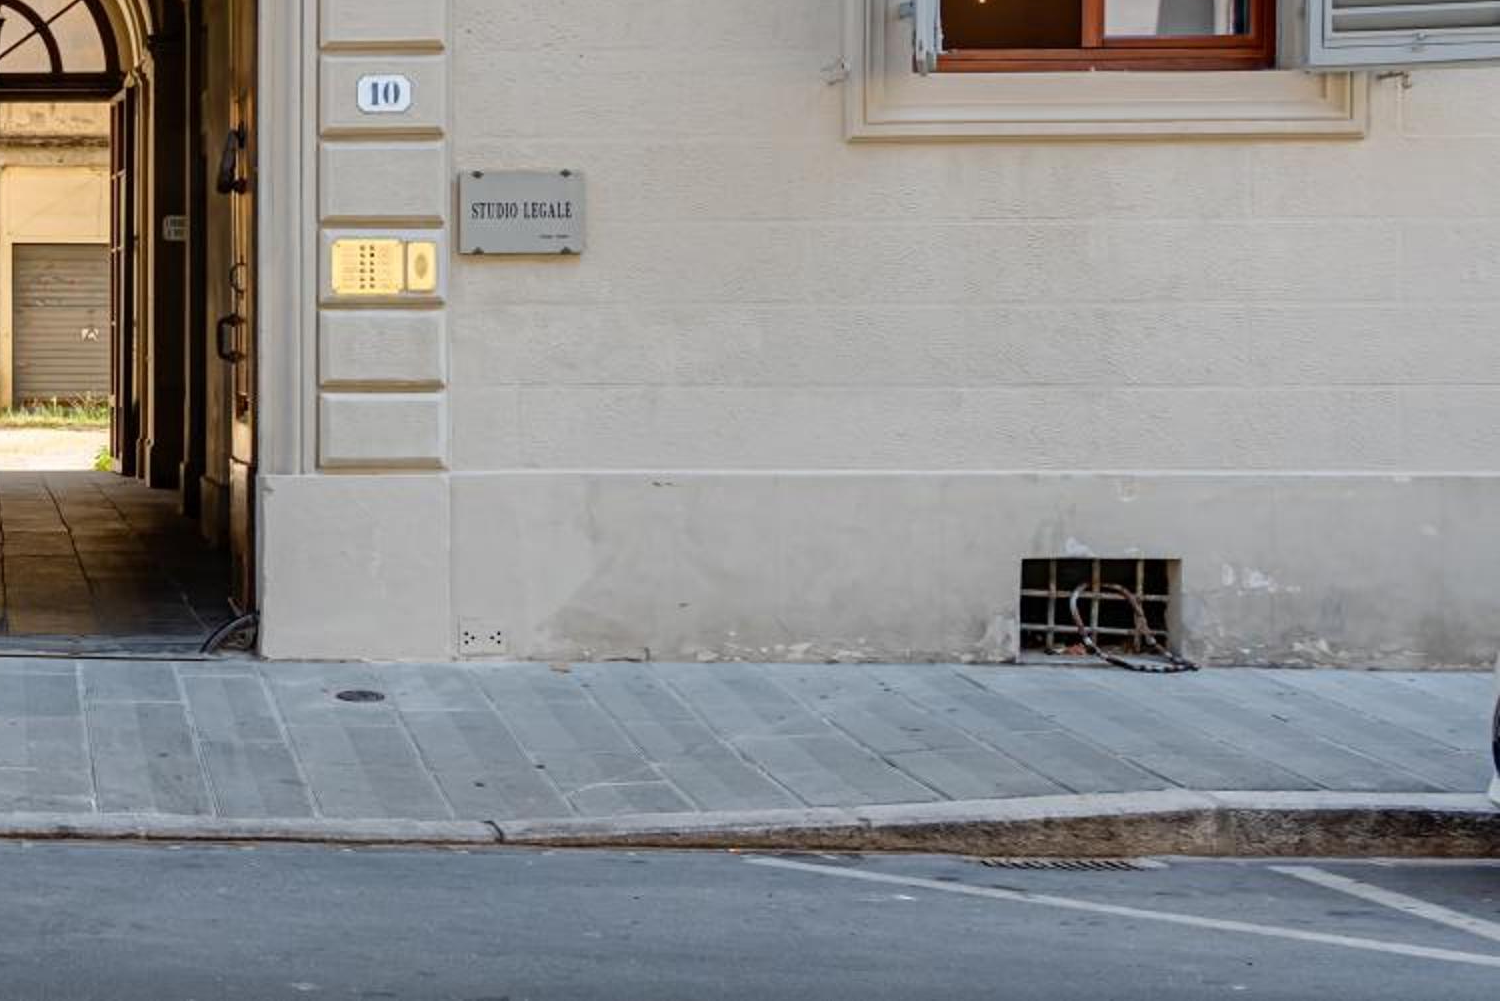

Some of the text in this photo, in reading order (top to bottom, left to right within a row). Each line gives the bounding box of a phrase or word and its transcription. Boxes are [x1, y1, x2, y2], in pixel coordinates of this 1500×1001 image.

[370, 82, 400, 105] 10
[471, 202, 572, 219] STUDIO LEGALE
